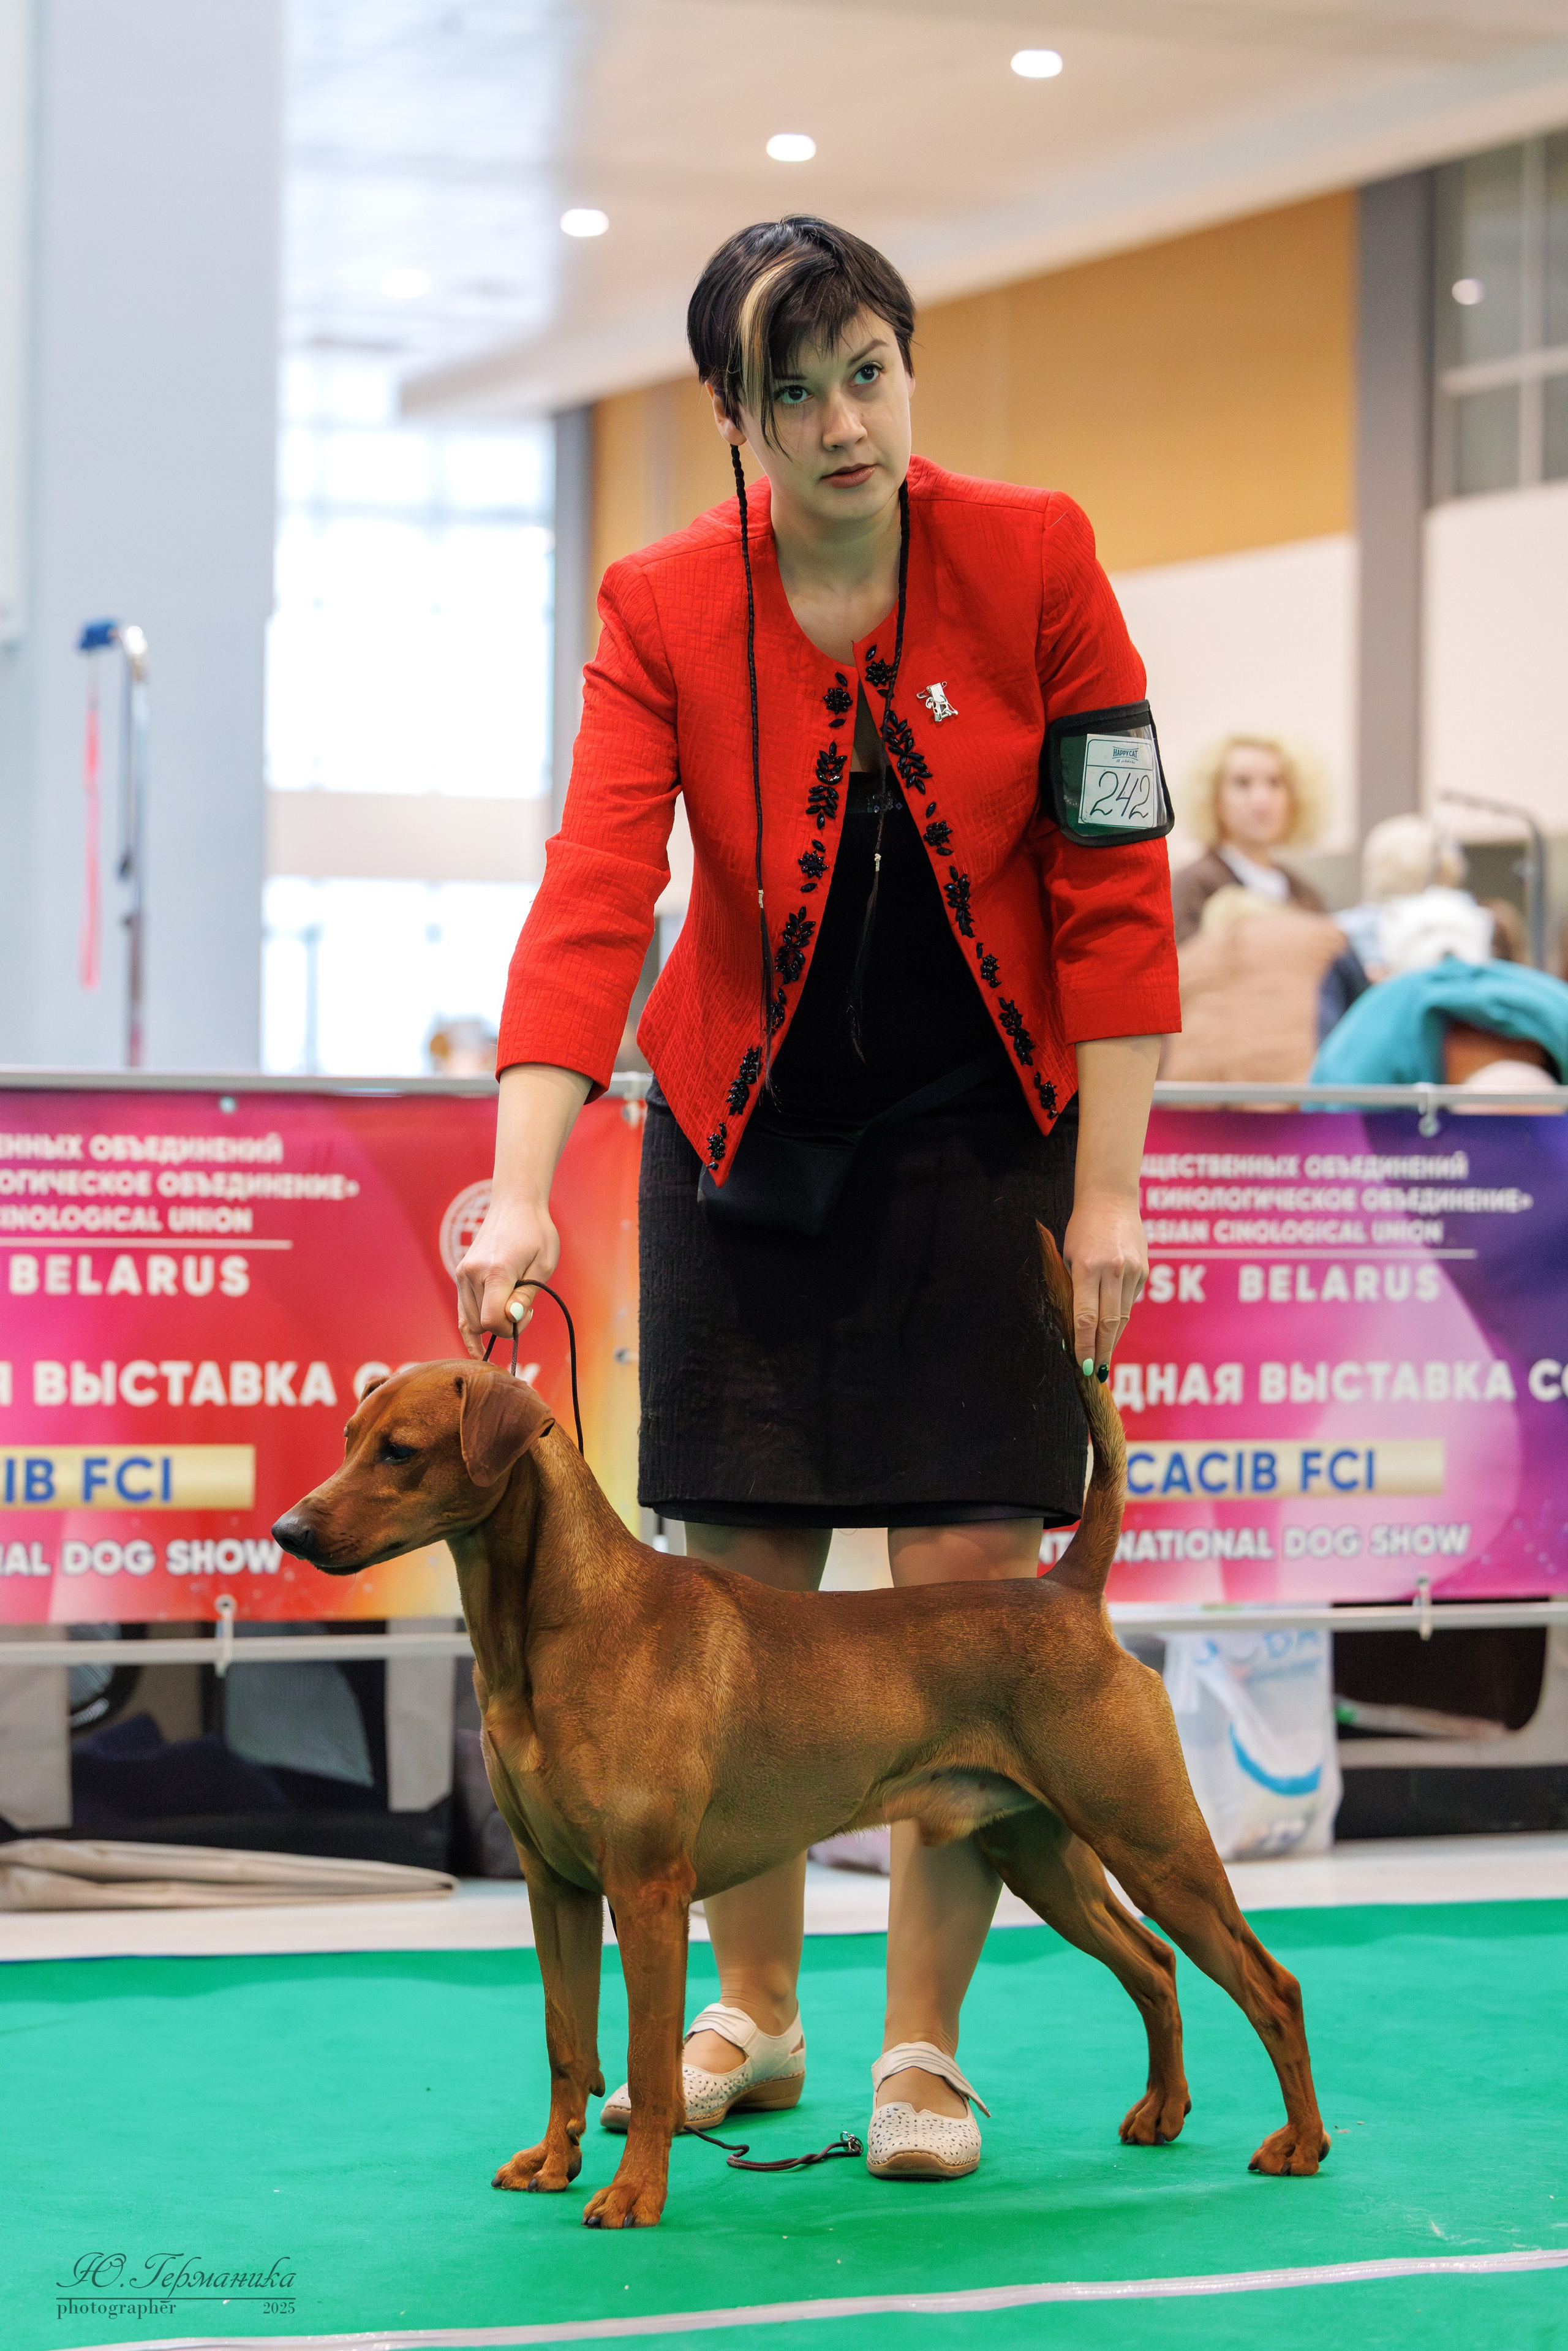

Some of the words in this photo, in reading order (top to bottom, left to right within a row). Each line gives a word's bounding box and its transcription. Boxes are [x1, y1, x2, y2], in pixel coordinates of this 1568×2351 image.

[1090, 771, 1150, 820] 242
[89, 1132, 284, 1165] ОБЪЕДИНЕНИЙ
[1303, 1150, 1469, 1182] ОБЪЕДИНЕНИЙ
[1146, 1186, 1357, 1212] КИНОЛОГИЧЕСКОЕ
[167, 1206, 253, 1233] UNION
[1213, 1218, 1366, 1245] CINOLOGICAL
[1371, 1219, 1444, 1245] UNION
[9, 1254, 251, 1297] BELARUS
[1135, 1264, 1207, 1304] SK
[1238, 1264, 1441, 1303] BELARUS
[33, 1359, 337, 1407] ВЫСТАВКА
[1106, 1362, 1245, 1413] ДНАЯ
[1259, 1359, 1517, 1405] ВЫСТАВКА
[1528, 1357, 1568, 1403] С
[4, 1455, 55, 1503] IB
[81, 1456, 172, 1503] FCI
[1127, 1451, 1278, 1495] CACIB
[1301, 1449, 1376, 1492] FCI
[0, 1540, 51, 1577] AL
[63, 1539, 156, 1577] DOG
[166, 1538, 284, 1577] SHOW
[1039, 1528, 1274, 1564] NTNATIONAL
[1283, 1526, 1362, 1559] DOG
[1370, 1523, 1472, 1557] SHOW
